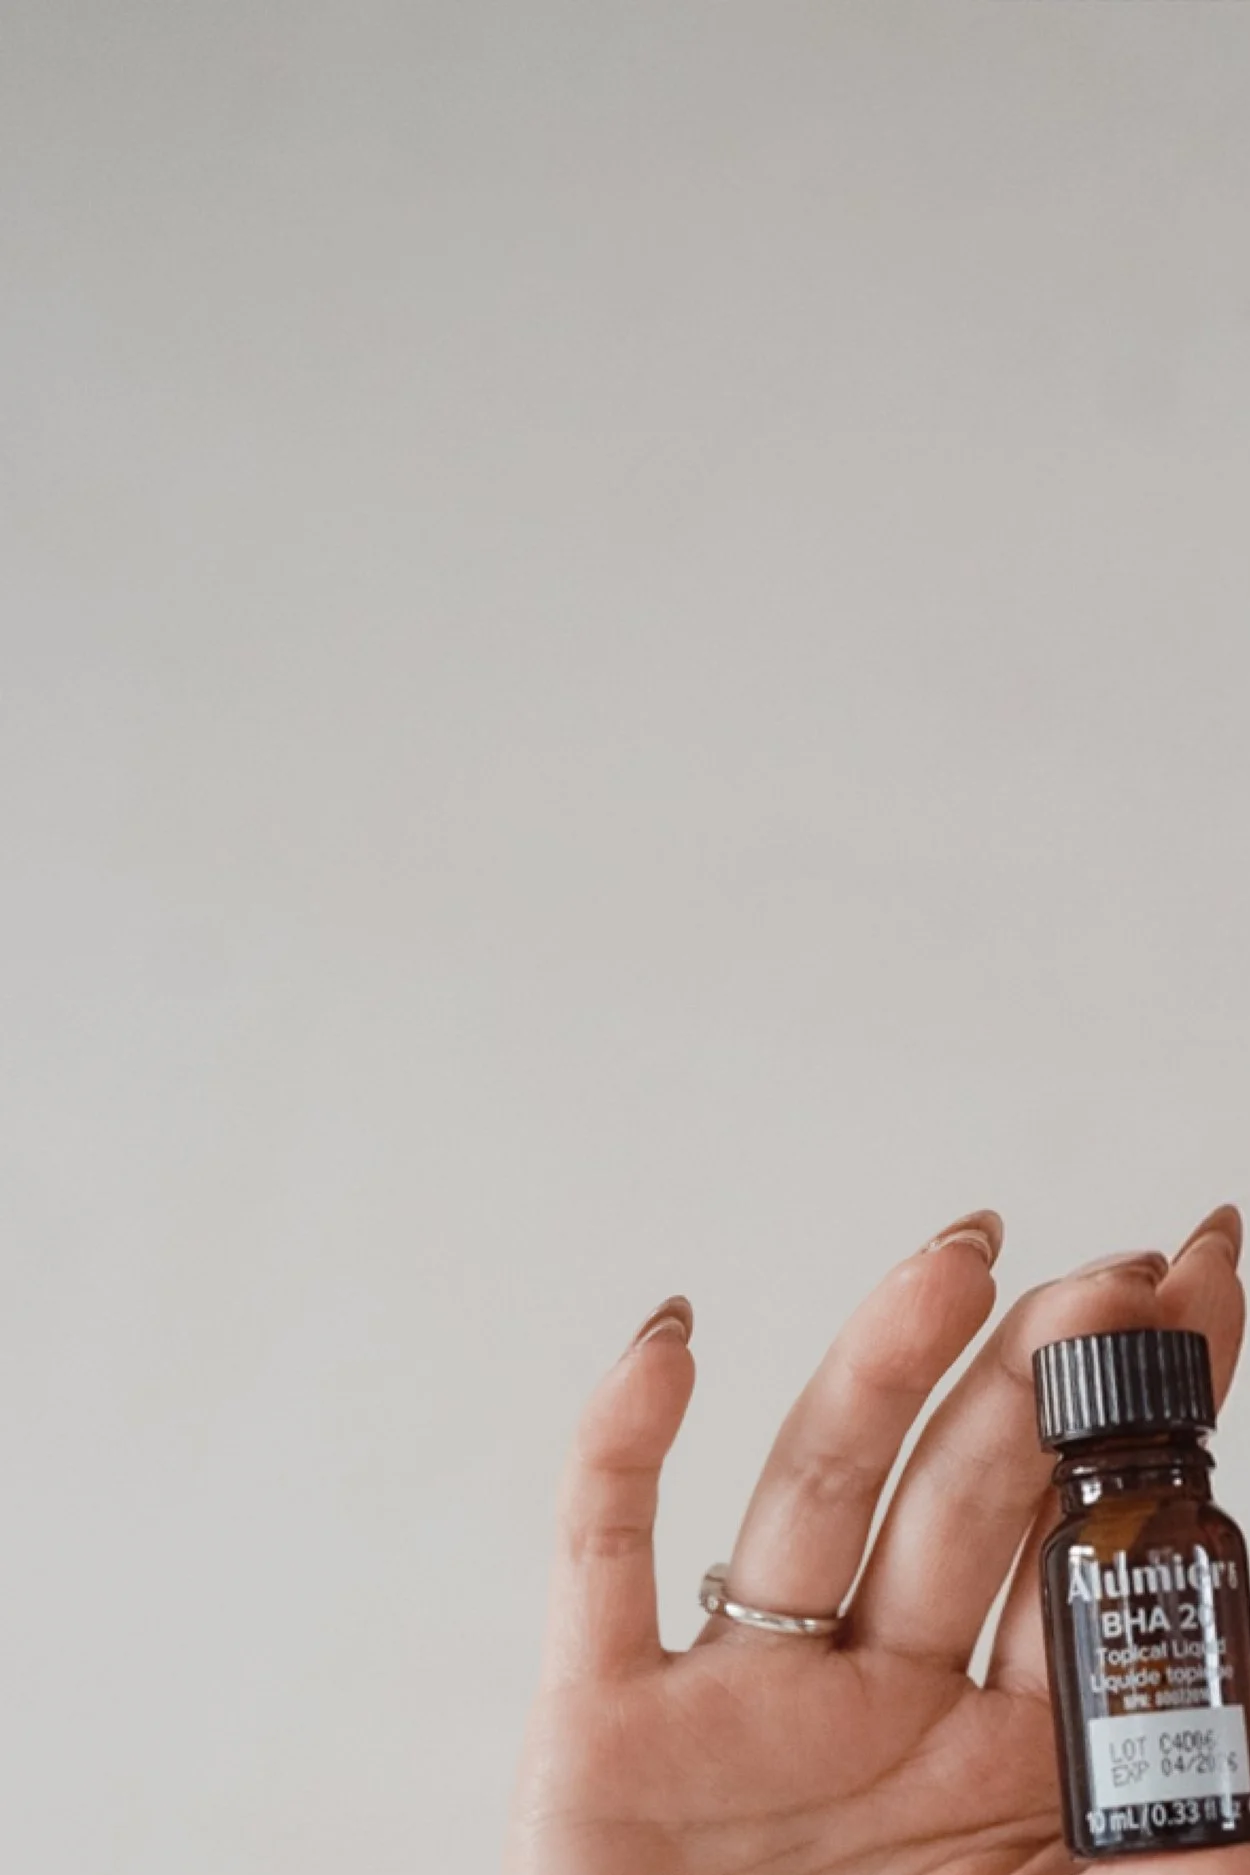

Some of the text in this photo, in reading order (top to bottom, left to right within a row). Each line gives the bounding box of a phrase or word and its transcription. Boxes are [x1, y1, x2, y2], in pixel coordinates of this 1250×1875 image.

[1101, 1602, 1215, 1638] BHA 2
[1095, 1637, 1227, 1666] Topical Liqd
[1166, 1662, 1233, 1685] topie
[1109, 1736, 1147, 1763] LOT
[1111, 1751, 1238, 1787] EXP 04/206
